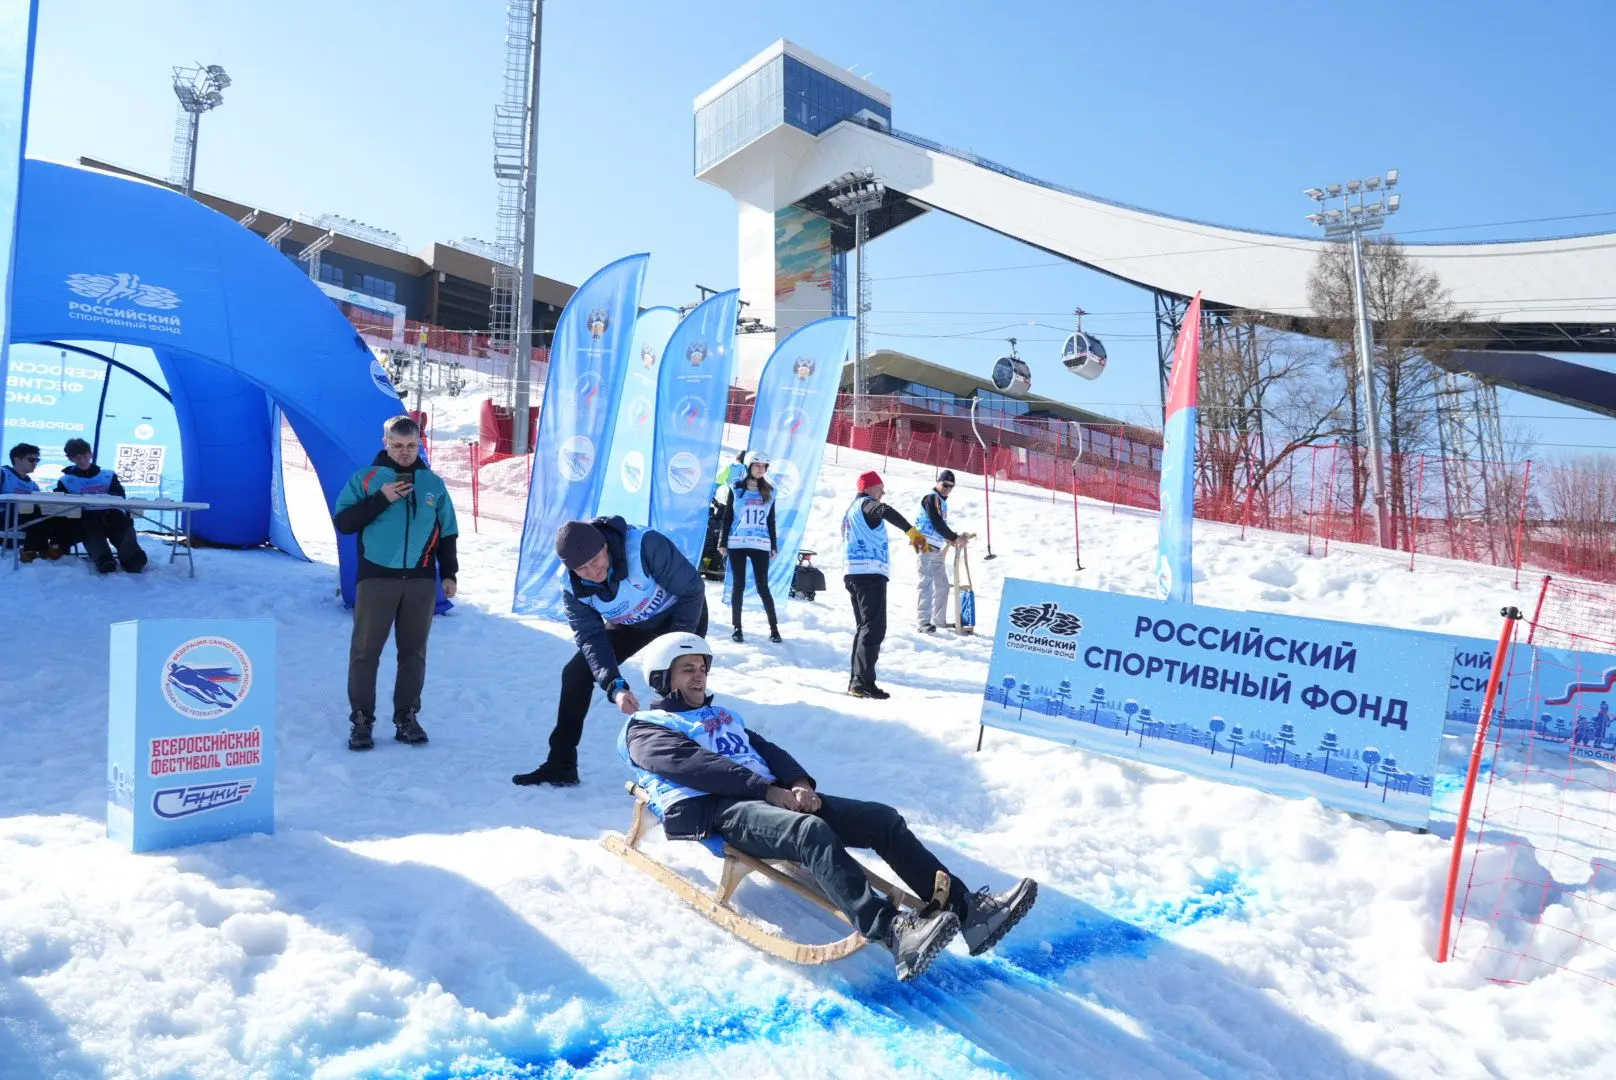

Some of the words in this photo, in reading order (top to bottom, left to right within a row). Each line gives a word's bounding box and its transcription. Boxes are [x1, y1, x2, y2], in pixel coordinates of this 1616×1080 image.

[69, 301, 181, 326] РОССИЙСКИЙ
[69, 312, 147, 330] СПОРТИВНЫЙ
[149, 323, 181, 335] ФОНД
[746, 508, 765, 526] 112
[1006, 641, 1053, 655] СПОРТИВНЫЙ
[1053, 648, 1075, 660] ФОНД
[1007, 632, 1077, 652] РОССИЙСКИЙ
[1134, 615, 1357, 674] РОССИЙСКИЙ
[1083, 645, 1292, 705] СПОРТИВНЫЙ
[1300, 683, 1408, 731] ФОНД
[151, 728, 260, 757] ВСЕРОССИЙСКИЙ
[151, 755, 221, 776] ФЕСТИВАЛЬ
[225, 749, 260, 766] САНОК
